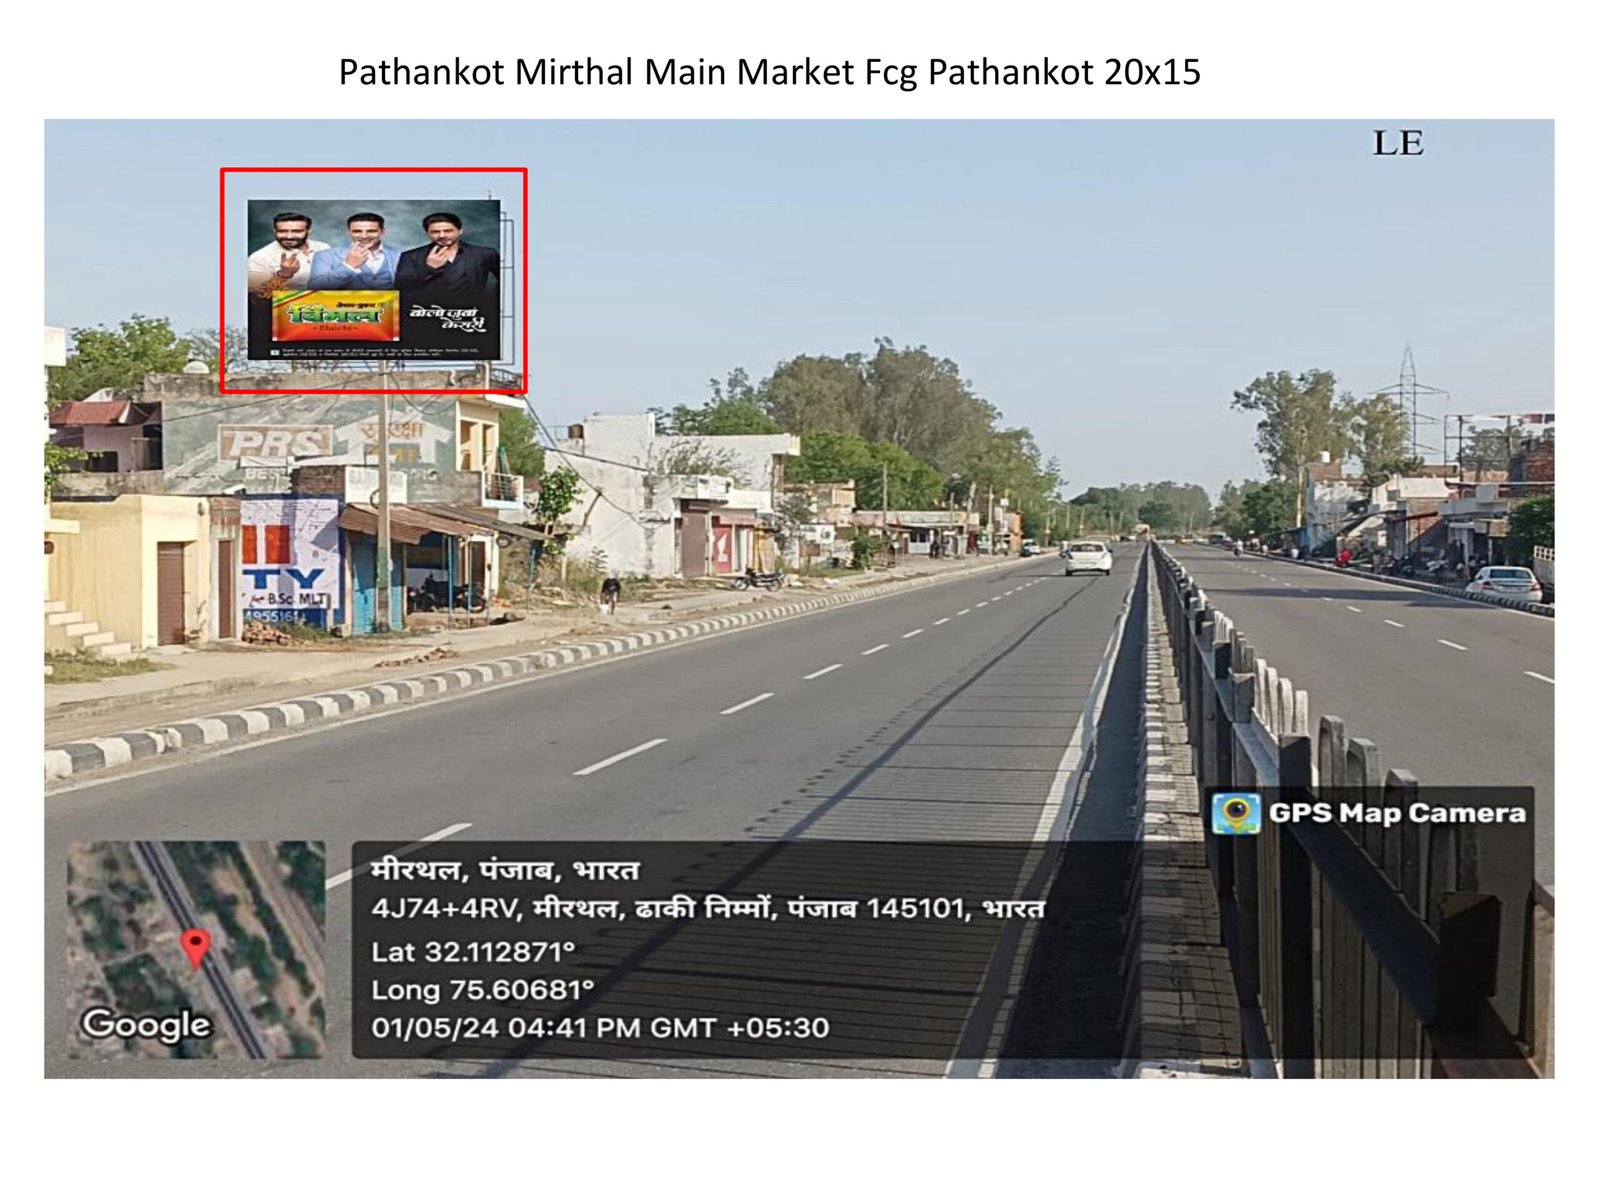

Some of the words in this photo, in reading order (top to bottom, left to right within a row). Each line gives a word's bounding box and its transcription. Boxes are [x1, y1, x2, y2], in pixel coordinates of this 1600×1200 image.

[286, 303, 385, 323] विमल
[409, 304, 446, 317] बोलो
[440, 316, 487, 333] केसरी
[223, 430, 324, 458] PRS
[242, 568, 326, 589] TY
